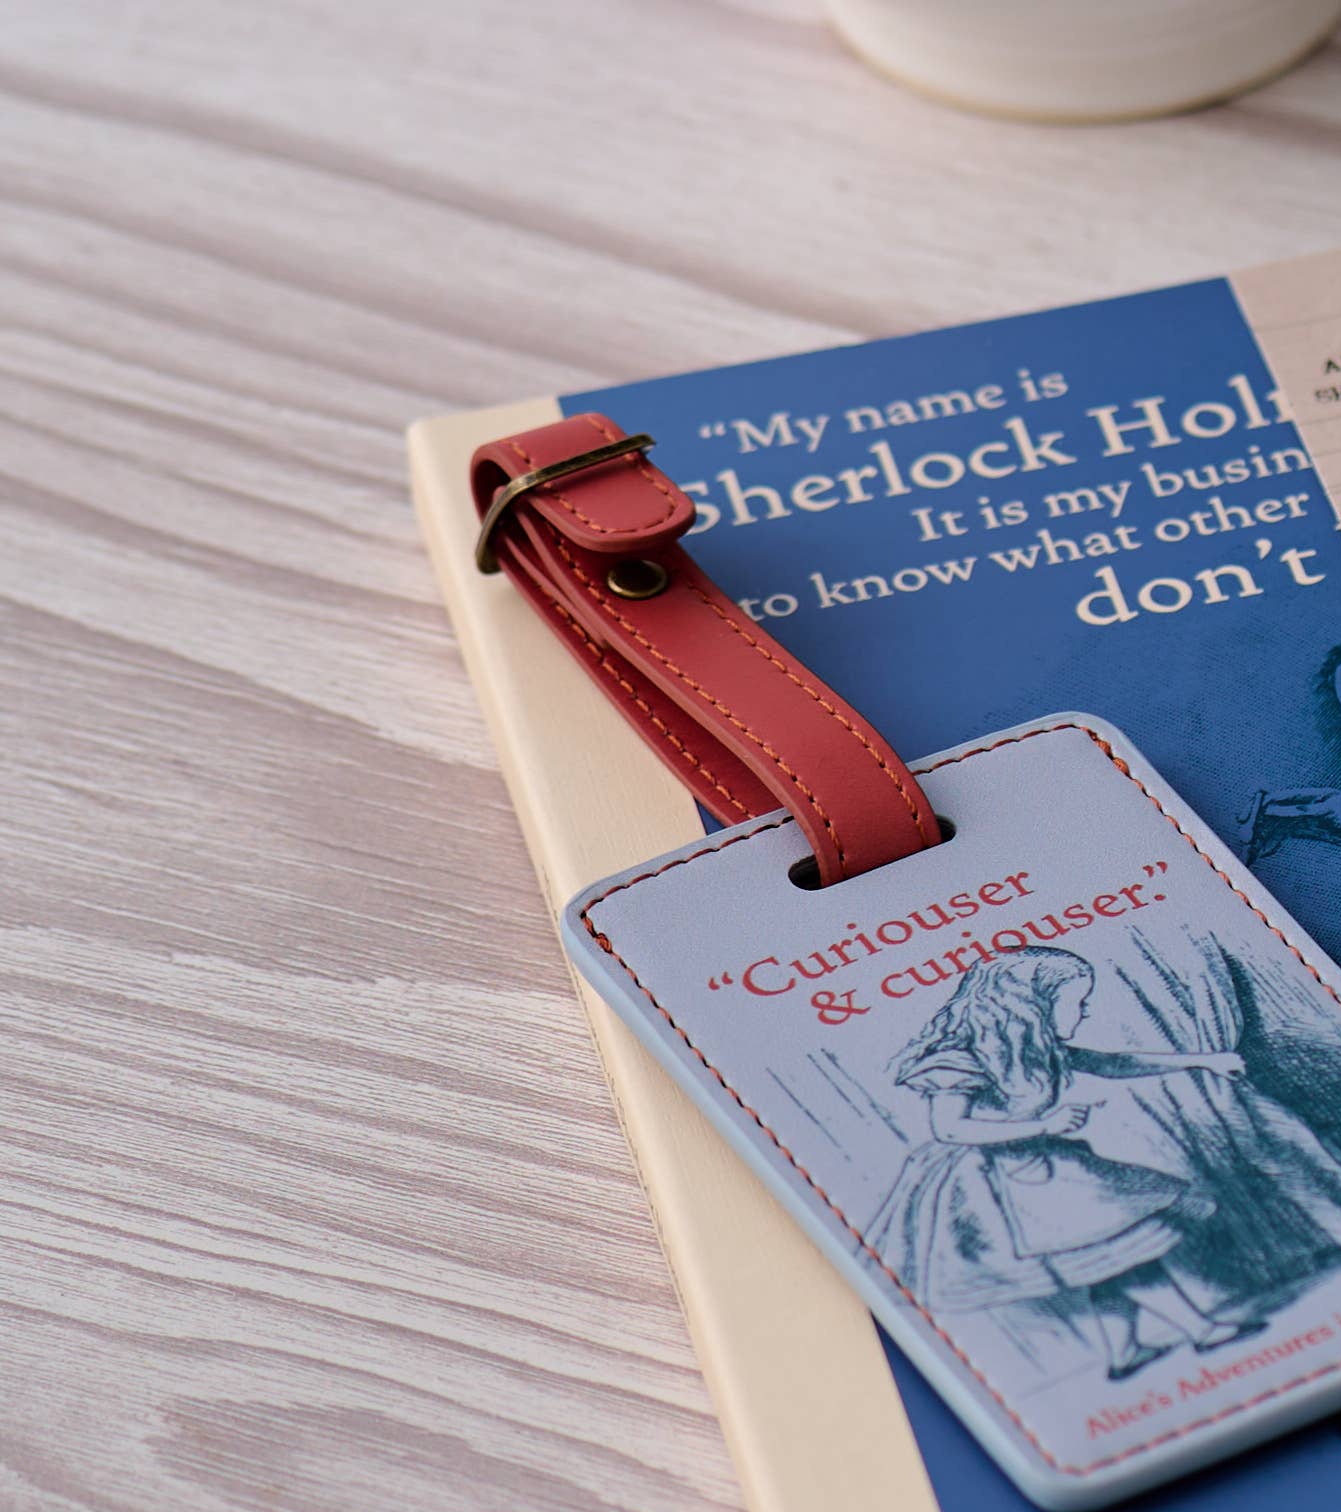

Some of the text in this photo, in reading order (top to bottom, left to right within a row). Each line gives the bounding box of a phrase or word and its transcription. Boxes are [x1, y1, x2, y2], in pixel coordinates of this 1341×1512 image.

[845, 383, 1007, 433] name
[1019, 368, 1069, 402] is
[683, 375, 1295, 535] Sherlock Hol
[911, 506, 969, 542] It
[979, 496, 1029, 529] is
[1045, 479, 1133, 518] my
[739, 490, 1309, 622] to know what other
[707, 870, 1036, 999] “Curiouser
[810, 988, 871, 1027] &
[1177, 1324, 1334, 1397] Adventures
